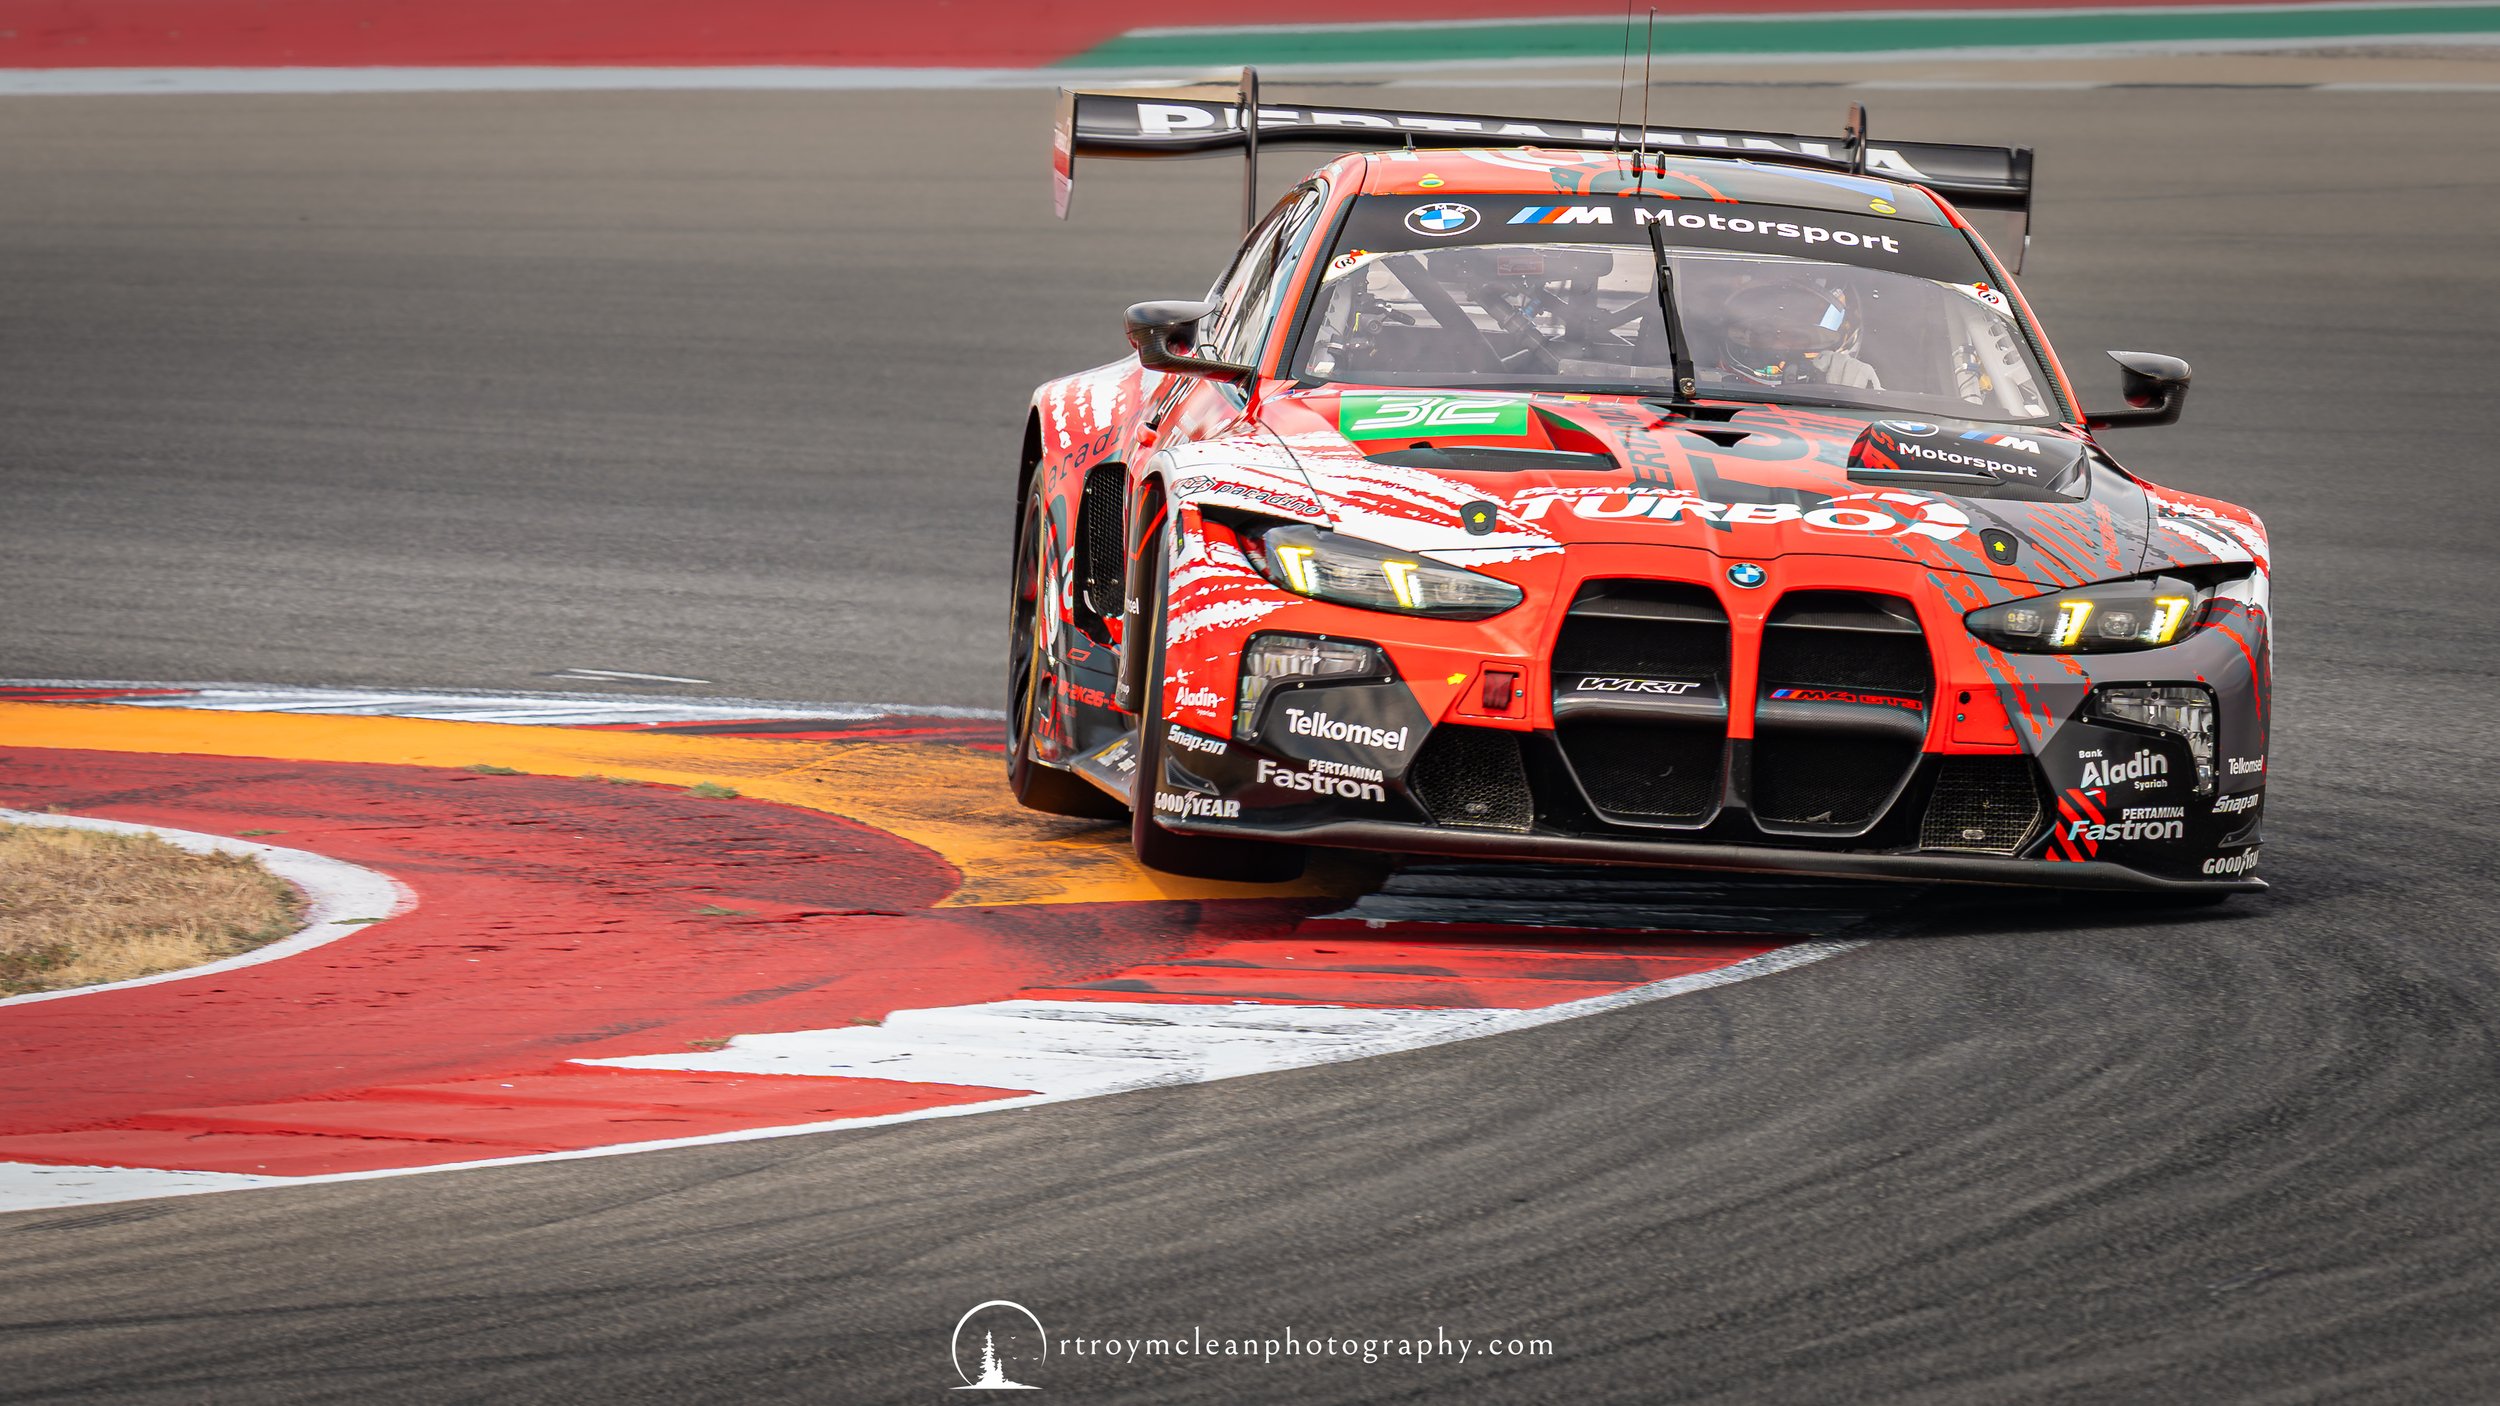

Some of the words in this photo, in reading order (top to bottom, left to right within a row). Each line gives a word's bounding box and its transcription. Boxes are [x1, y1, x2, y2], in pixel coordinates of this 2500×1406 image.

[1634, 208, 1899, 254] Motorsport
[1349, 396, 1519, 431] 32
[1899, 442, 2038, 478] Motorsport
[1214, 483, 1320, 515] paradine
[1513, 486, 1696, 499] PERTAMAX
[1508, 493, 1899, 534] TURBO
[1175, 686, 1218, 708] Aladin
[1576, 677, 1700, 695] WRT
[1168, 724, 1228, 756] Snap-on
[1286, 707, 1408, 751] Telkomsel
[2078, 749, 2103, 759] Bank
[2228, 754, 2264, 775] Telkomsel
[1256, 758, 1386, 802] Fastron
[1308, 758, 1384, 783] PERTAMINA
[2080, 749, 2169, 789] Aladin
[2134, 778, 2168, 791] Syariah
[1154, 791, 1241, 820] GOODYEAR
[2122, 806, 2185, 821] PERTAMINA
[2212, 793, 2259, 815] Snap-on
[2067, 820, 2184, 842] Fastron
[2202, 848, 2260, 876] GOODYEA
